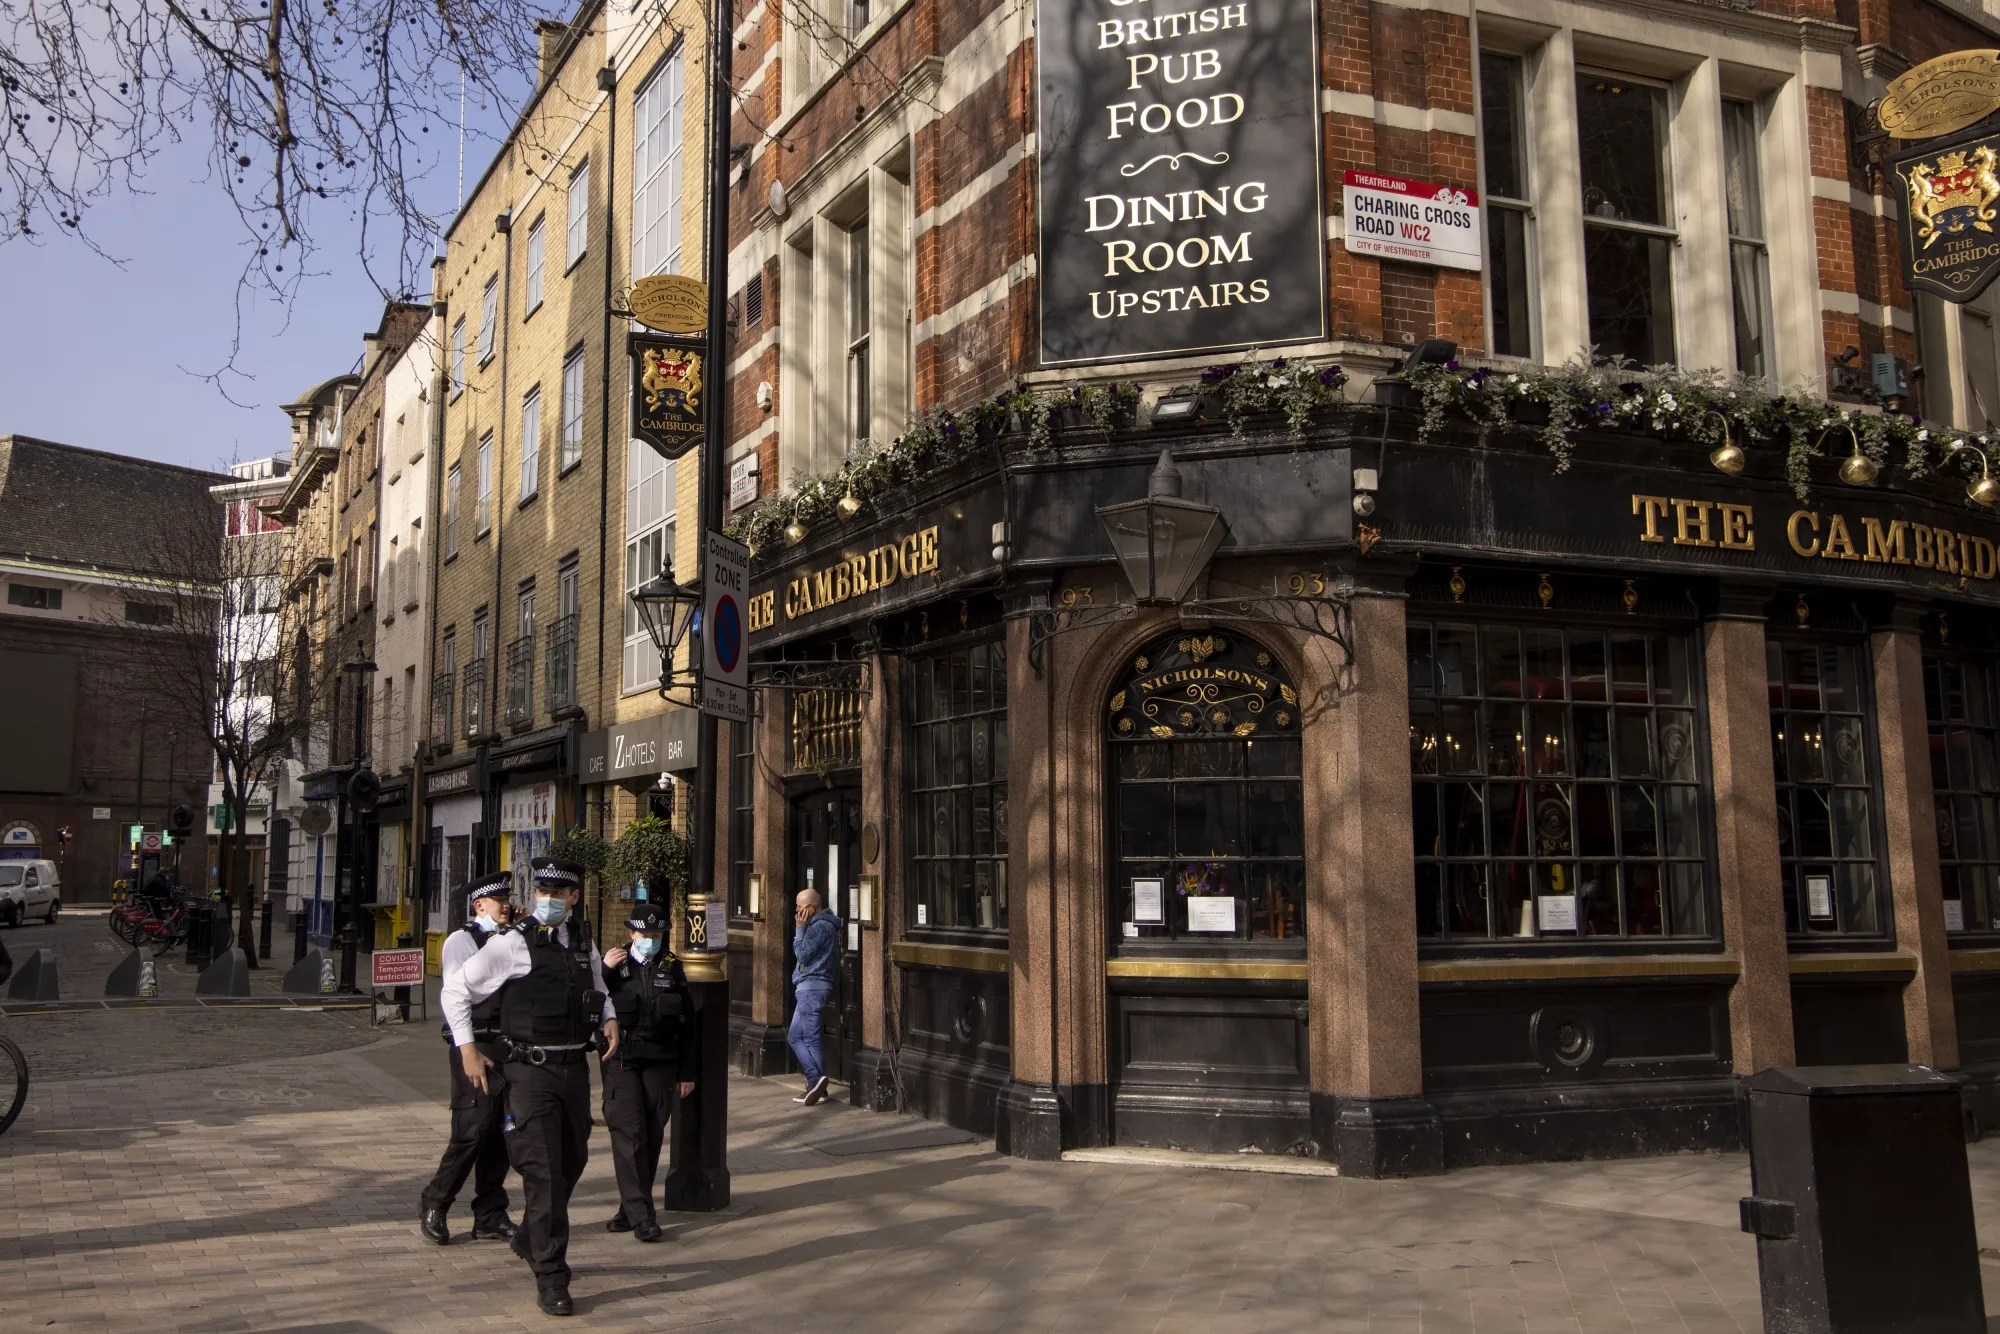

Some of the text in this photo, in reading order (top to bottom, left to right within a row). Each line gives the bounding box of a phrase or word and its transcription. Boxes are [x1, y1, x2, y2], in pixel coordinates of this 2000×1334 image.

[1097, 3, 1248, 49] BRITISH
[1126, 49, 1222, 90] PUB
[1943, 58, 1967, 68] 1873
[1893, 78, 1997, 119] NICHOLSON'S
[1106, 93, 1245, 140] FOOD
[1916, 102, 1974, 122] FREEHOUSE
[1354, 174, 1407, 192] THEATRELAND
[1084, 181, 1269, 232] DINING
[1354, 194, 1471, 229] CHARING CROSS
[1355, 215, 1431, 242] ROAD WC2
[1103, 231, 1253, 277] ROOM
[1356, 240, 1431, 259] CITY OF WESTMINSTER
[1912, 242, 2000, 274] CAMBRIDG
[1943, 238, 1974, 252] THE
[640, 294, 708, 313] NICHOLSON'S
[1088, 279, 1270, 319] UPSTAIRS
[655, 312, 694, 320] FREEHOUSE
[640, 418, 705, 433] CAMBRIDGE
[662, 412, 682, 421] THE
[1632, 494, 2000, 579] THE CAMBRID
[709, 538, 748, 569] Controlled
[714, 563, 742, 592] ZONE
[749, 525, 939, 632] HE CAMBRIDGE
[1288, 572, 1325, 596] 93
[1060, 587, 1094, 607] 93
[1139, 667, 1269, 693] NICHOLSON'S
[716, 687, 725, 698] Mon
[729, 690, 737, 701] Sat
[589, 756, 604, 773] CAFE
[668, 740, 683, 760] BAR
[378, 965, 418, 973] Temporary
[379, 953, 417, 963] COVID-19
[376, 972, 420, 981] restrictions
